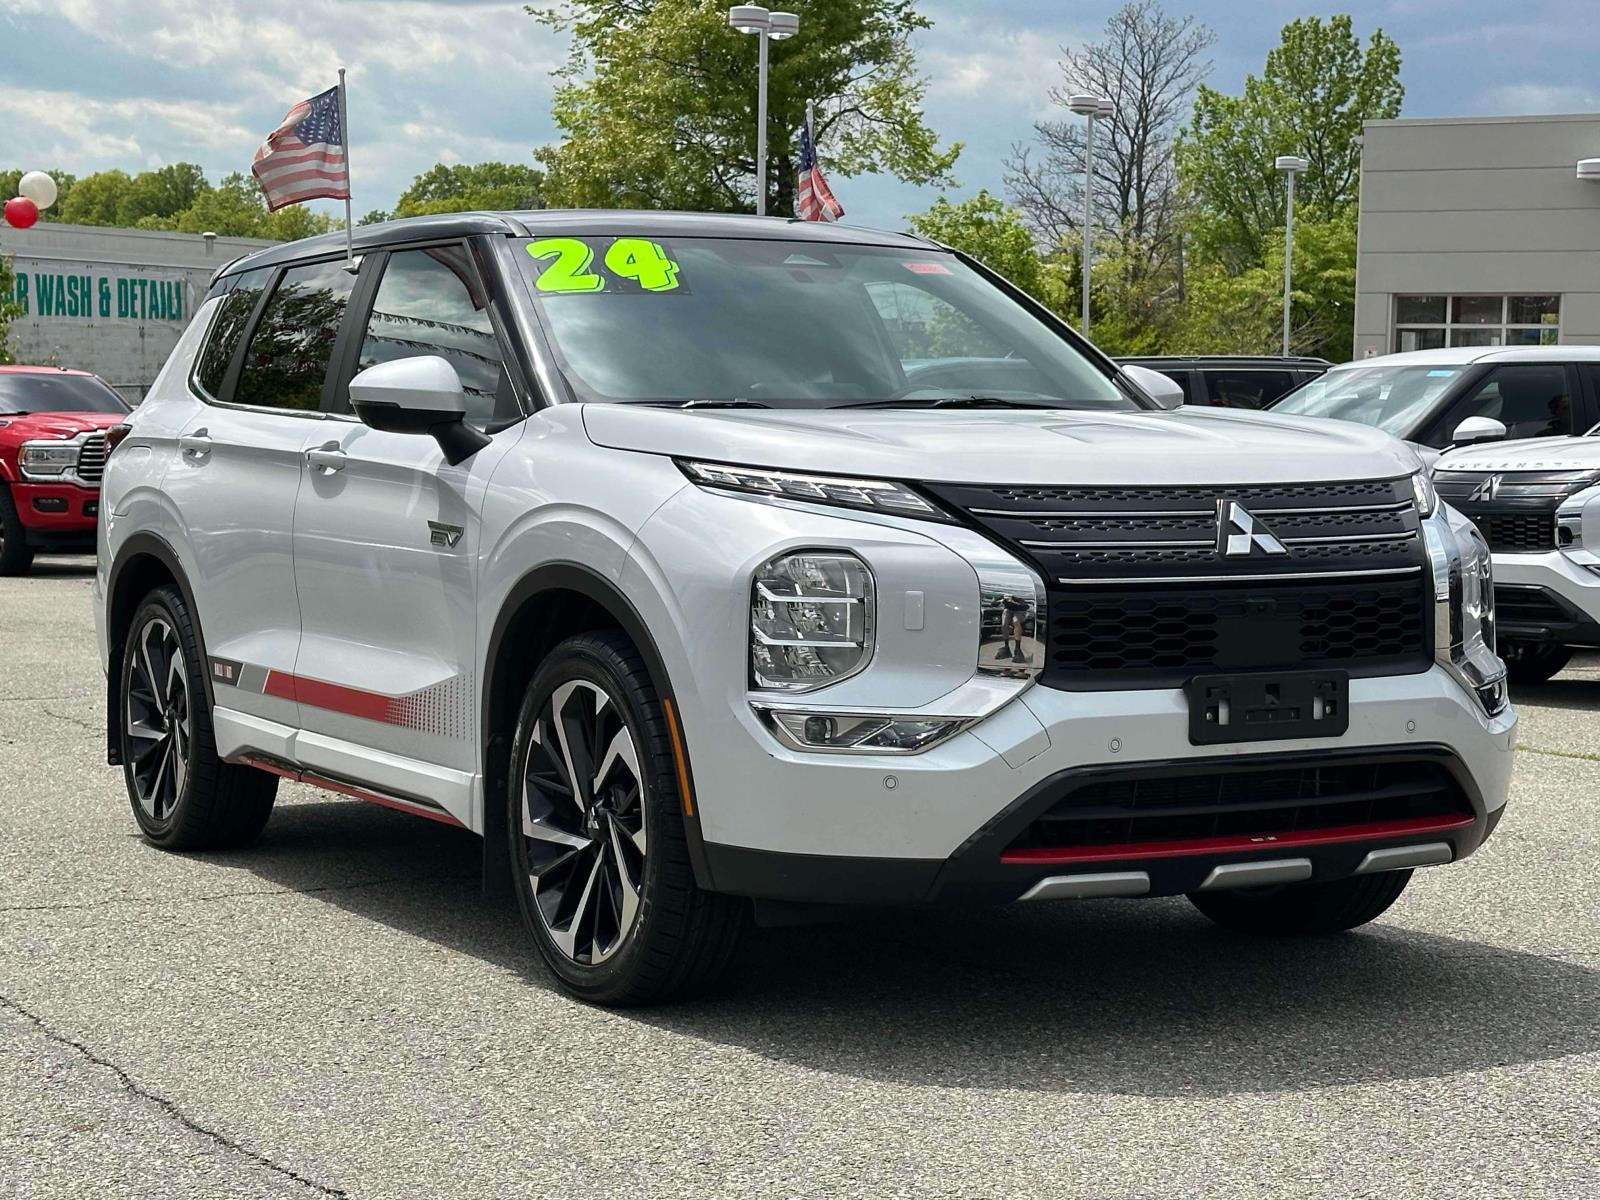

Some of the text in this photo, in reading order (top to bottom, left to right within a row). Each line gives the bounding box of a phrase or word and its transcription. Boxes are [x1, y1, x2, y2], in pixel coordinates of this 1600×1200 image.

[526, 238, 680, 294] 24
[35, 273, 92, 317] WASH
[98, 277, 111, 317] &
